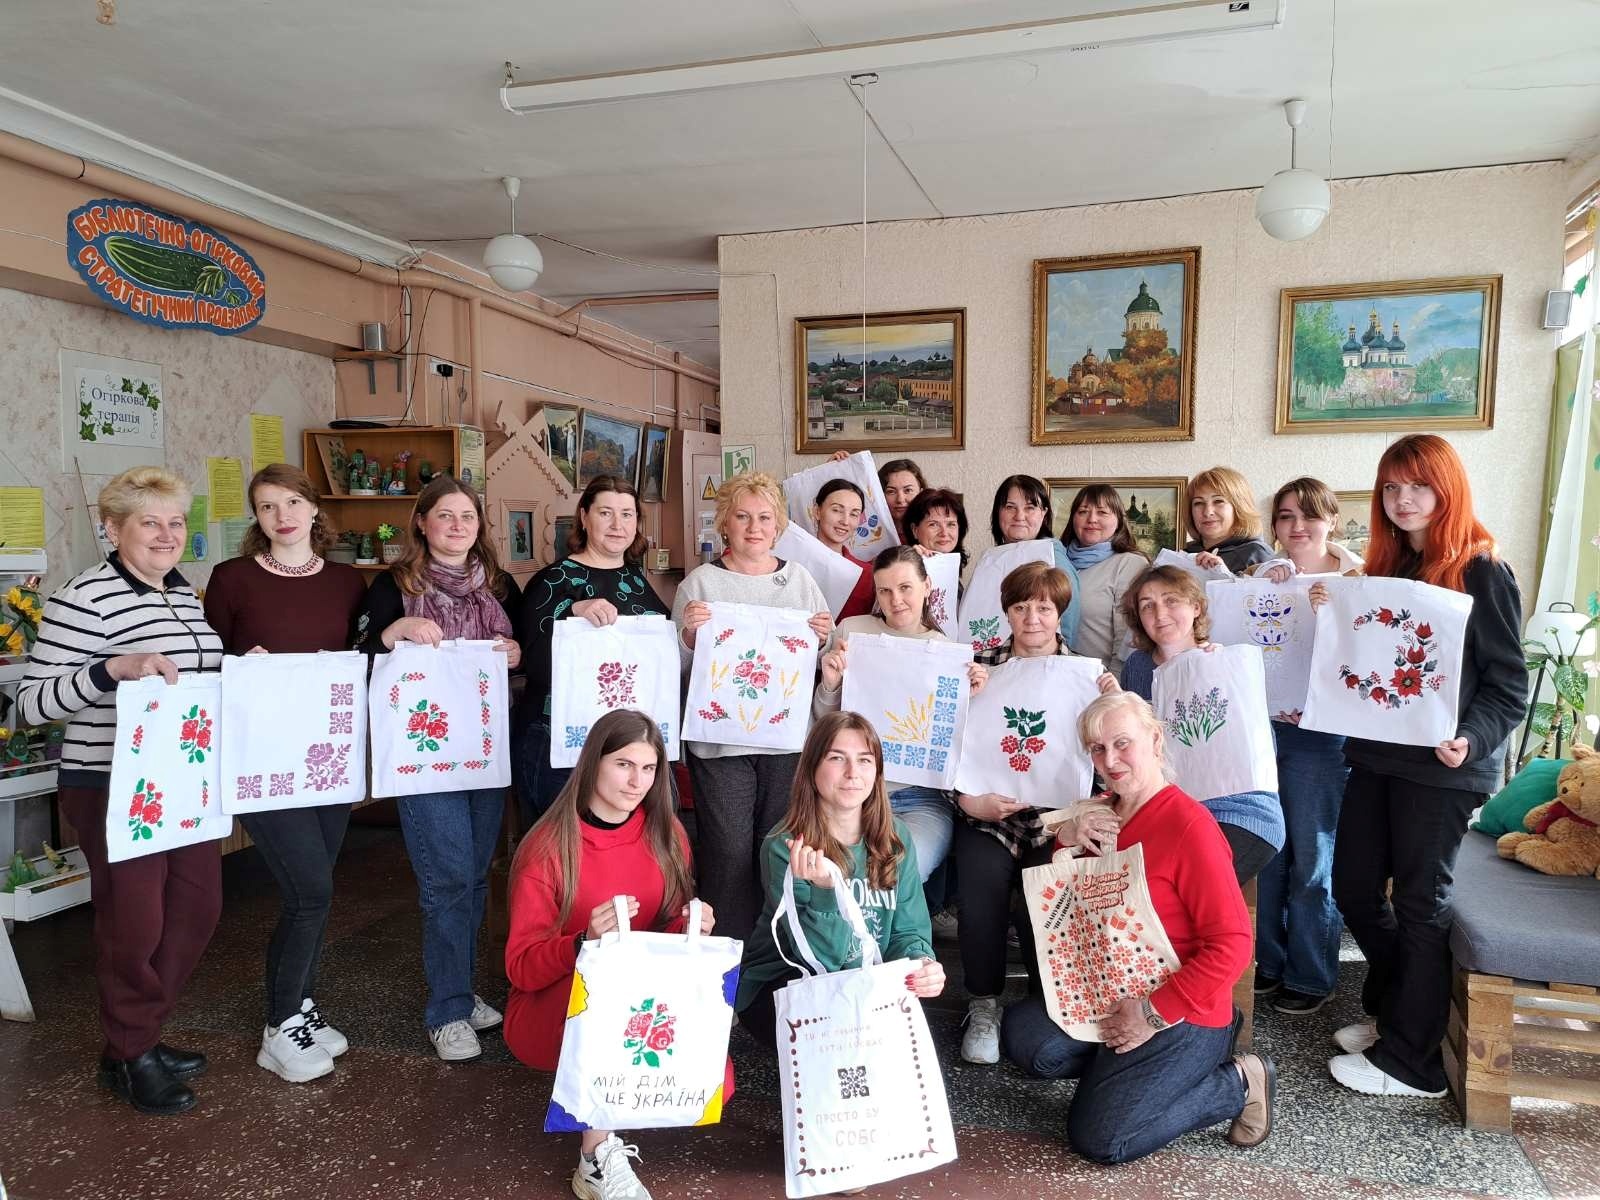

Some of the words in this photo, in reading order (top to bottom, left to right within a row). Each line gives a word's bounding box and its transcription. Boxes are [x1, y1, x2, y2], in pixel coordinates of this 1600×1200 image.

[79, 245, 196, 323] СТРАТЕГІЧНИЙ
[197, 299, 261, 329] ПРОДЗАПАС
[92, 387, 145, 406] Огіркова
[97, 410, 140, 424] терапія
[594, 1072, 626, 1087] МІЙ
[637, 1075, 676, 1088] ДІМ
[605, 1091, 625, 1106] ЦЕ
[631, 1088, 705, 1110] УКРАЇНА
[816, 1110, 858, 1126] ПРОСТО
